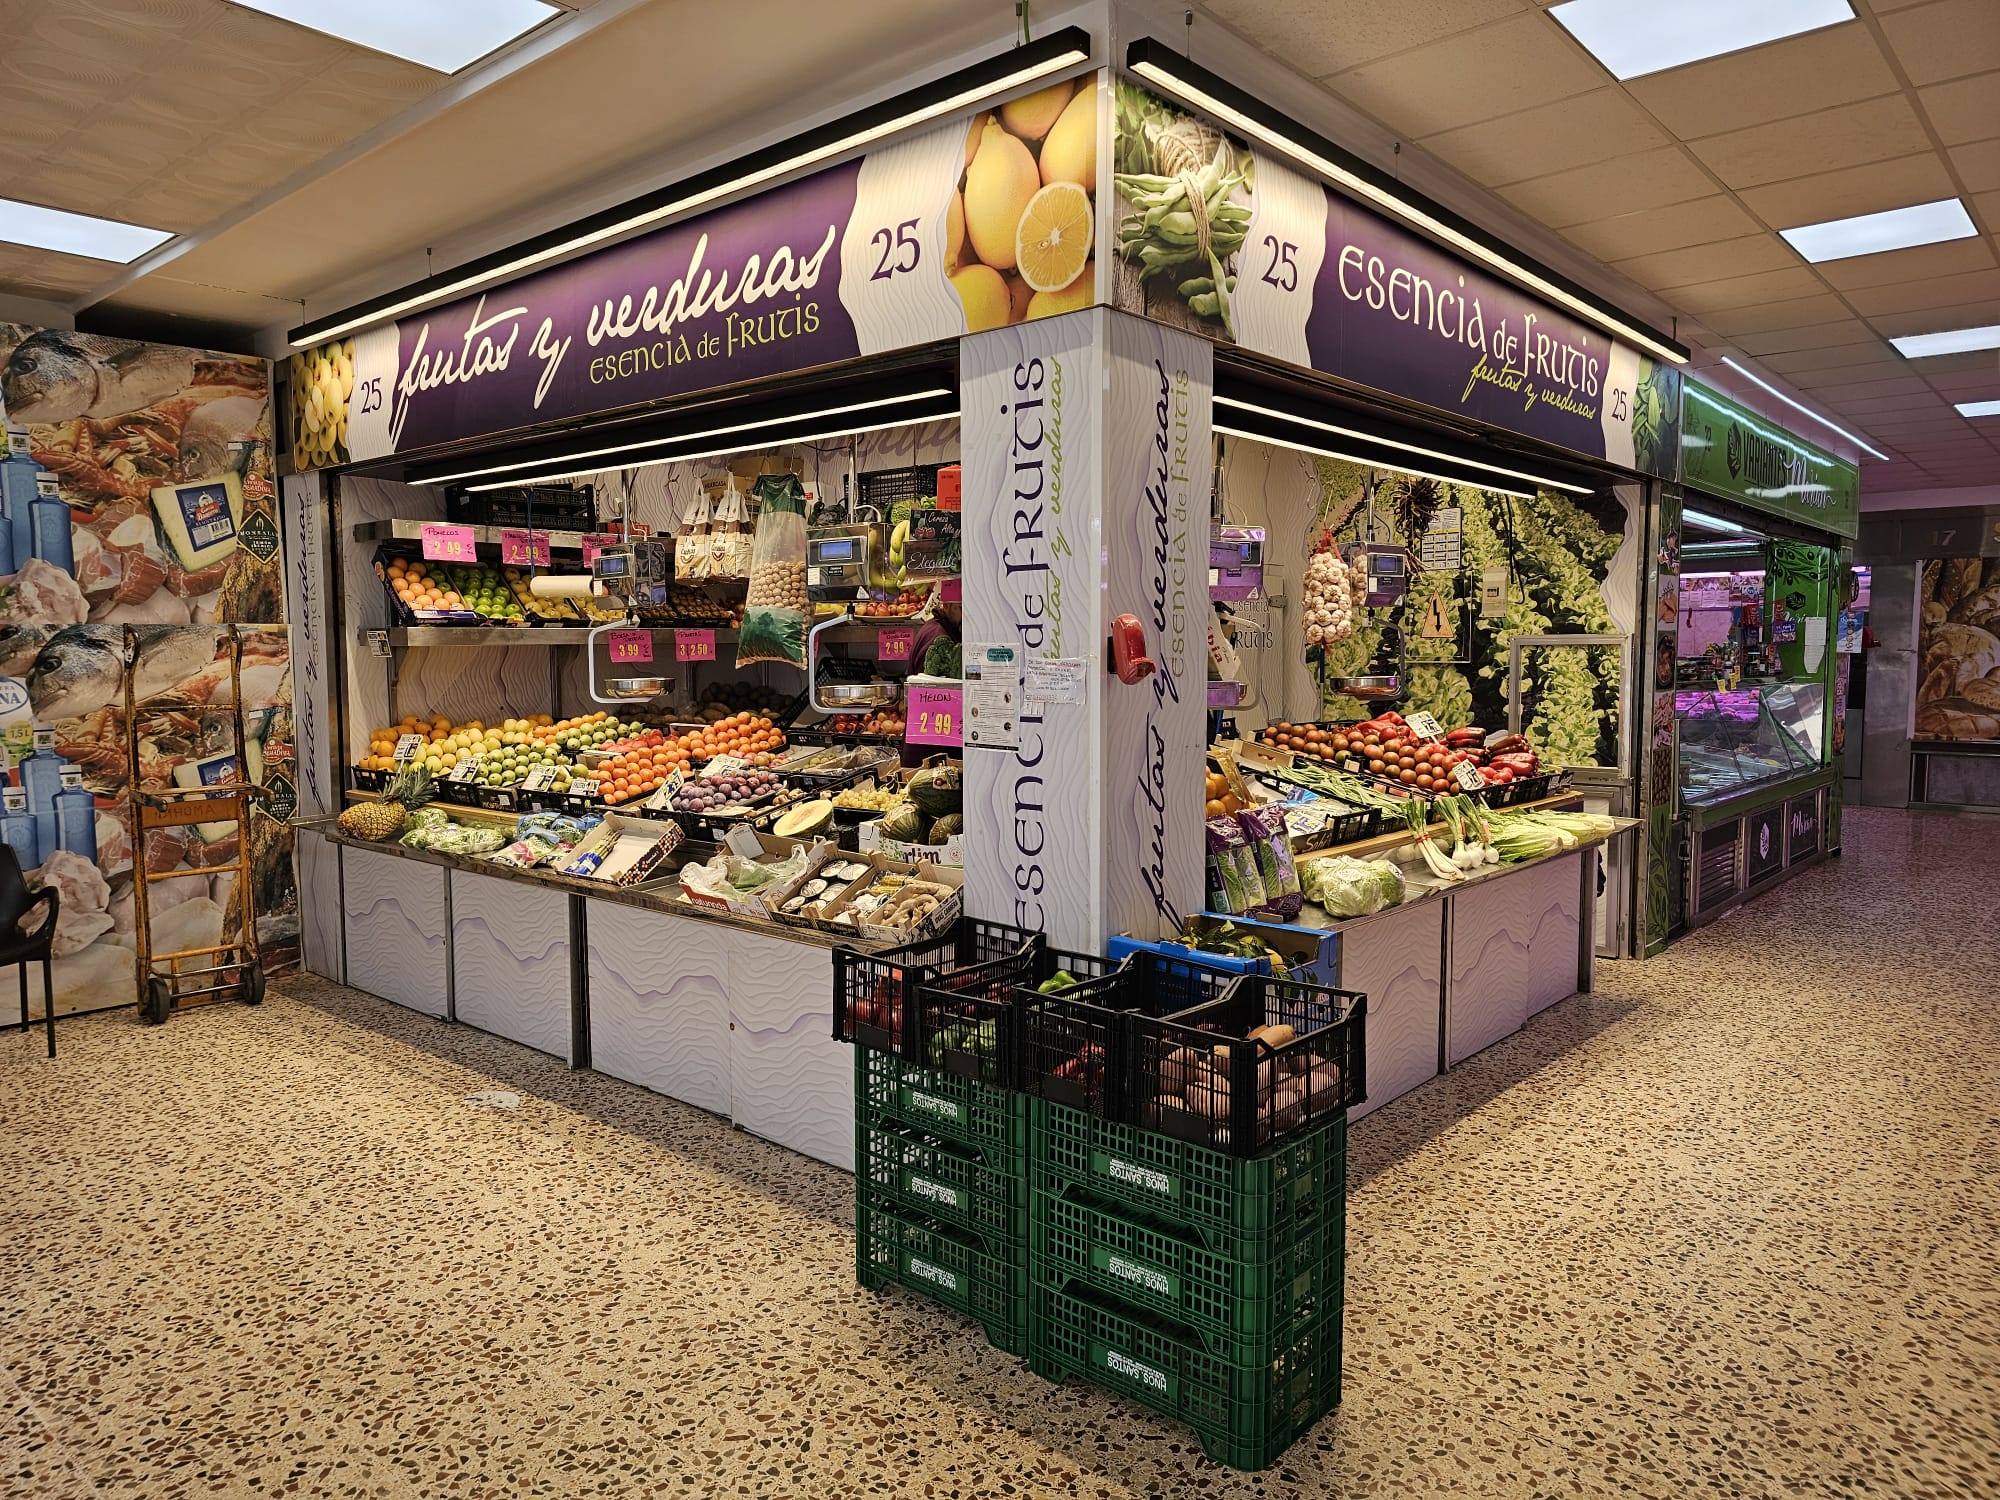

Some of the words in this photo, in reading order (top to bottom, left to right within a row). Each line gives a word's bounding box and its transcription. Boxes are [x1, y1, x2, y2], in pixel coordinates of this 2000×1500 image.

[871, 218, 922, 282] 25
[1261, 235, 1298, 292] 25
[1338, 244, 1487, 352] esencia
[1492, 323, 1519, 364] de
[389, 294, 529, 454] frutas
[529, 317, 573, 409] y
[586, 224, 837, 347] verduras
[589, 327, 693, 385] esencia
[697, 335, 721, 360] de
[361, 378, 382, 414] 25
[1460, 352, 1523, 403] frutas
[1523, 382, 1538, 412] y
[1541, 384, 1596, 421] verduras
[1612, 388, 1628, 422] 25
[1043, 356, 1063, 514] verduras
[1146, 358, 1170, 633] verduras
[1172, 493, 1187, 523] de
[297, 492, 313, 640] verduras
[1050, 526, 1073, 561] y
[1015, 593, 1043, 648] de
[1169, 531, 1187, 677] esencia
[1152, 653, 1178, 709] y
[301, 685, 326, 815] frutas
[1015, 677, 1044, 937] esenci
[1138, 711, 1183, 936] frutas
[1109, 1165, 1142, 1184] SANTOS
[1143, 1176, 1170, 1194] HNOS.
[911, 1264, 936, 1282] SANTOS
[1109, 1263, 1142, 1283] SANTOS
[1143, 1275, 1169, 1294] HNOS.
[1108, 1357, 1139, 1379] SANTOS
[1142, 1371, 1167, 1392] HNOS.
